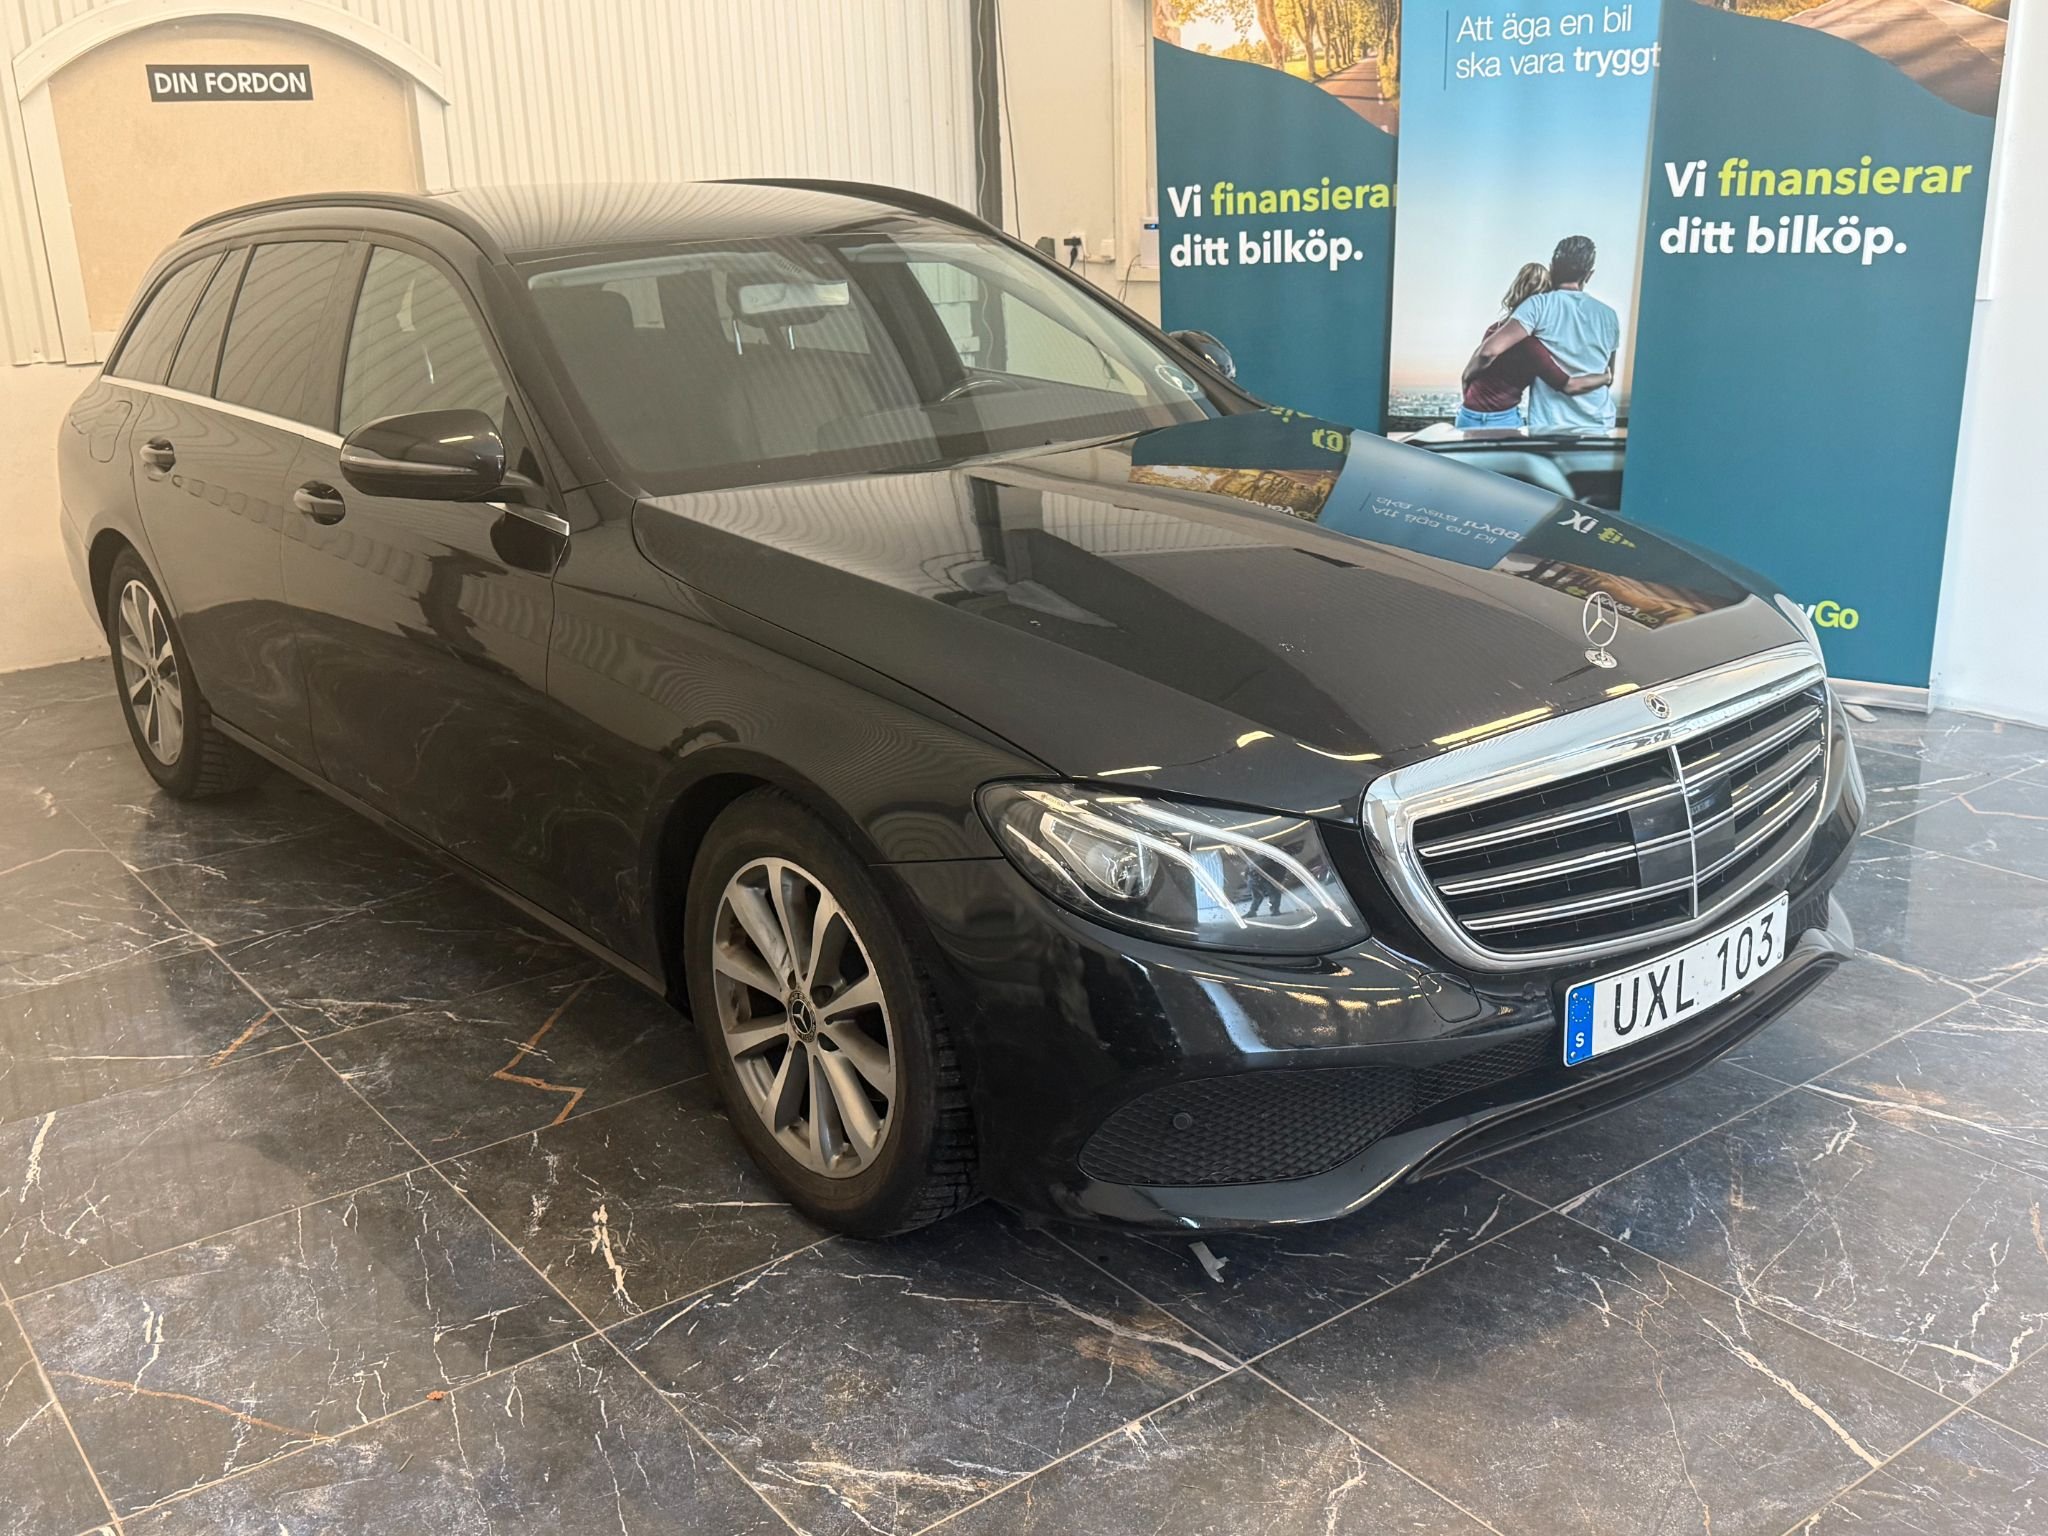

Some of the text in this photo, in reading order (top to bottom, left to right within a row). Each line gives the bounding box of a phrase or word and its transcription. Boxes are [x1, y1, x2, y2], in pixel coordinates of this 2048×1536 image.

[1456, 4, 1632, 45] Att äga en bil
[1456, 41, 1662, 79] ska vara tryggt
[154, 72, 307, 93] DIN FORDON
[1664, 155, 1973, 197] Vi finansierar
[1167, 184, 1202, 218] Vi
[1170, 228, 1363, 271] ditt bilköp.
[1660, 214, 1907, 265] ditt bilköp.
[1614, 912, 1774, 1036] UXL 103
[1575, 1032, 1584, 1047] S
